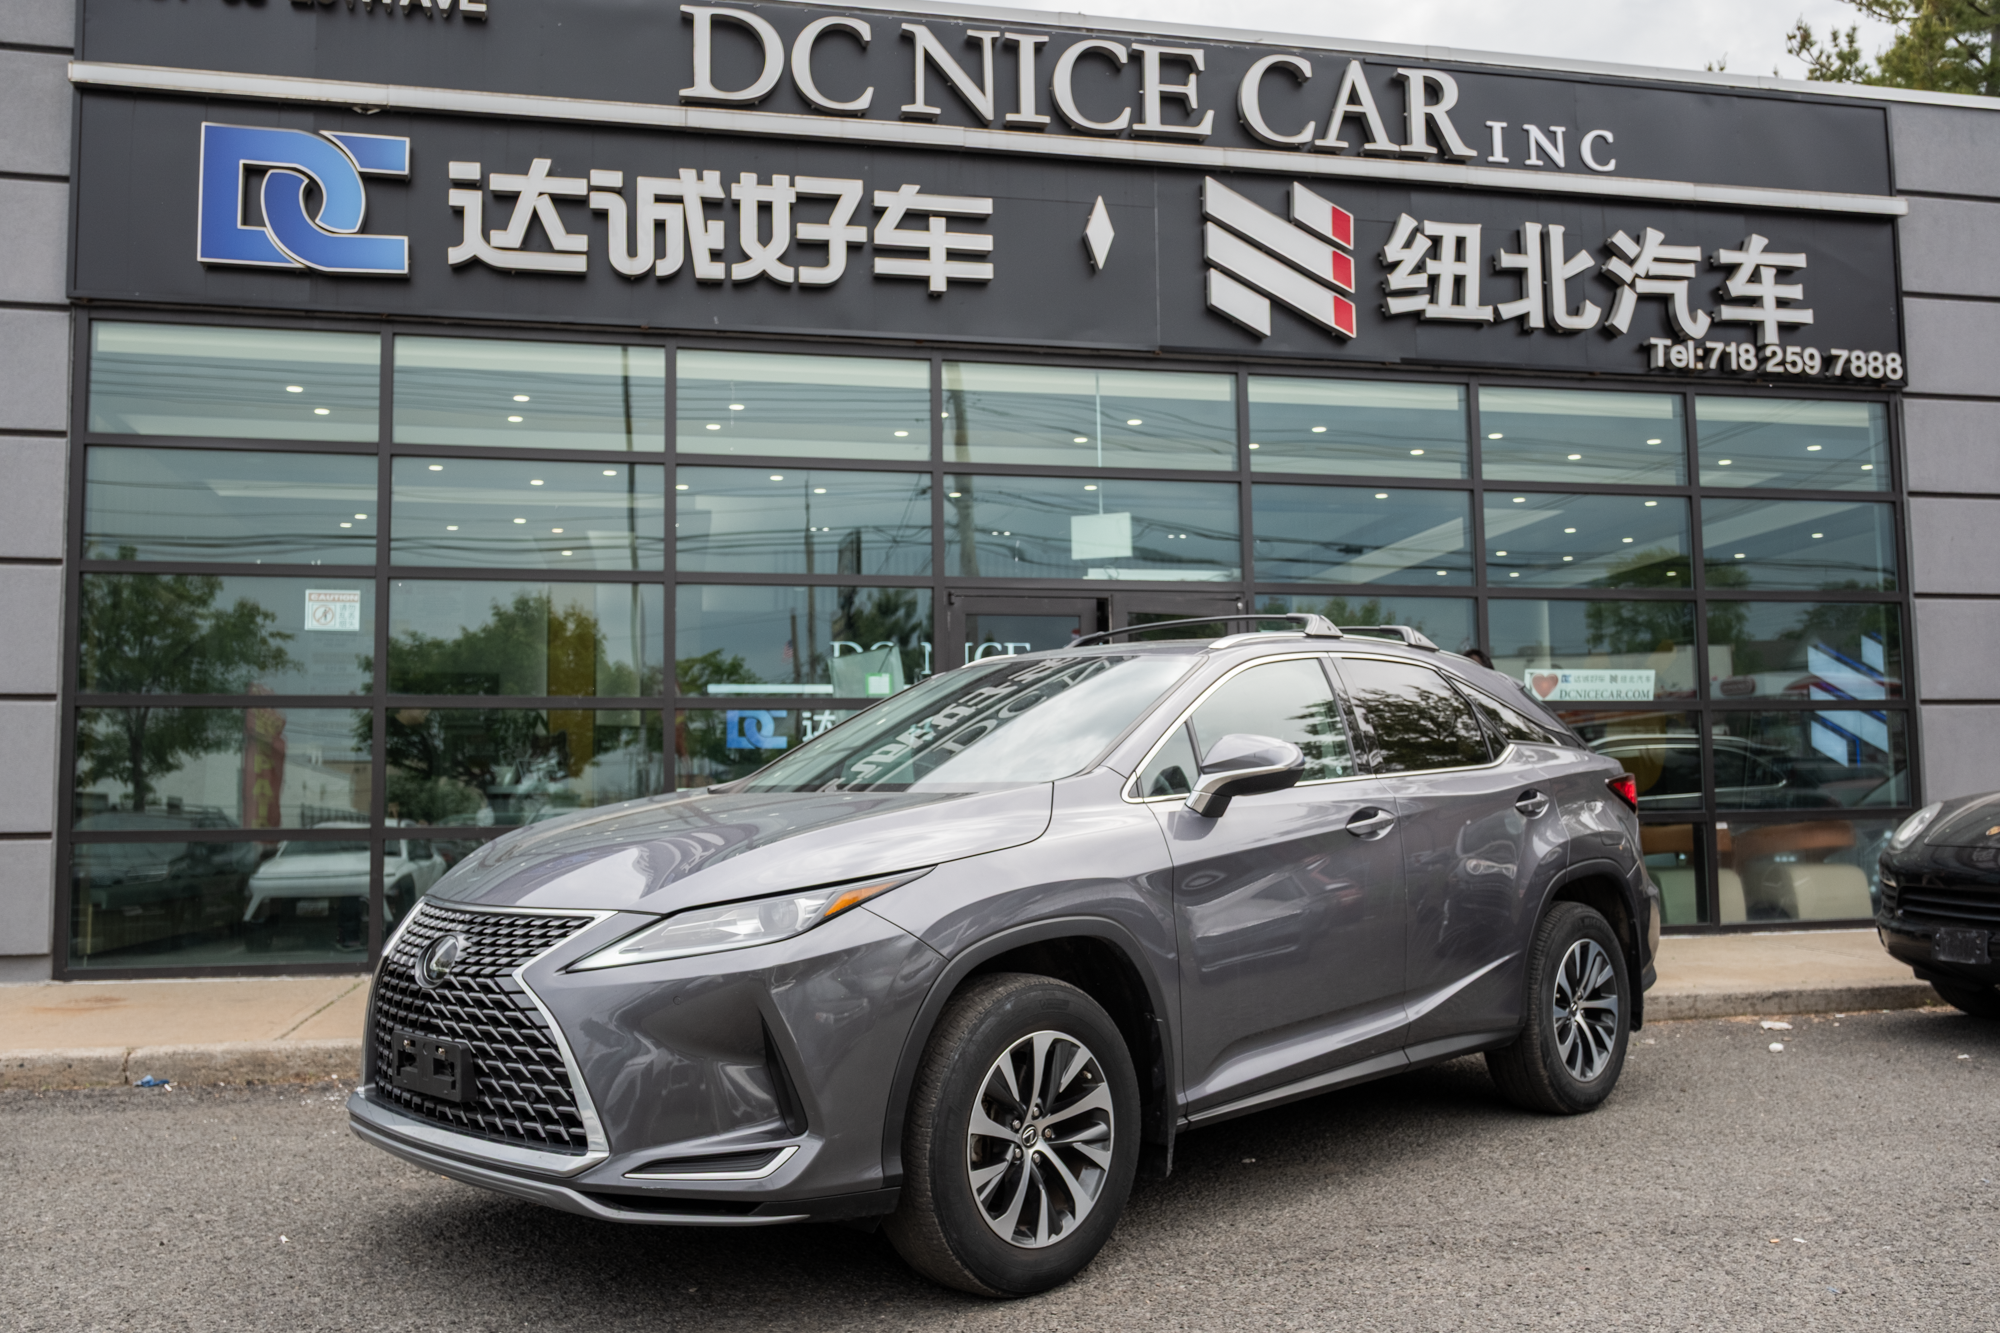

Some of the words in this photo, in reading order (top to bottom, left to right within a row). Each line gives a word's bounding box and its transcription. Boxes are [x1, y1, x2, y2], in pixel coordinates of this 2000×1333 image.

[678, 4, 875, 115] DC
[899, 22, 1215, 140] NICE
[1236, 53, 1478, 161] CAR
[1485, 120, 1617, 172] INC
[196, 121, 411, 277] DC
[447, 157, 994, 295] 达诚好车
[1379, 212, 1814, 345] 纽北汽车
[1648, 336, 1758, 372] Tel:718
[1763, 344, 1822, 375] 259
[1829, 347, 1904, 381] 7888
[310, 592, 359, 602] CAUTION
[1559, 689, 1650, 700] DCNICECAR.COM
